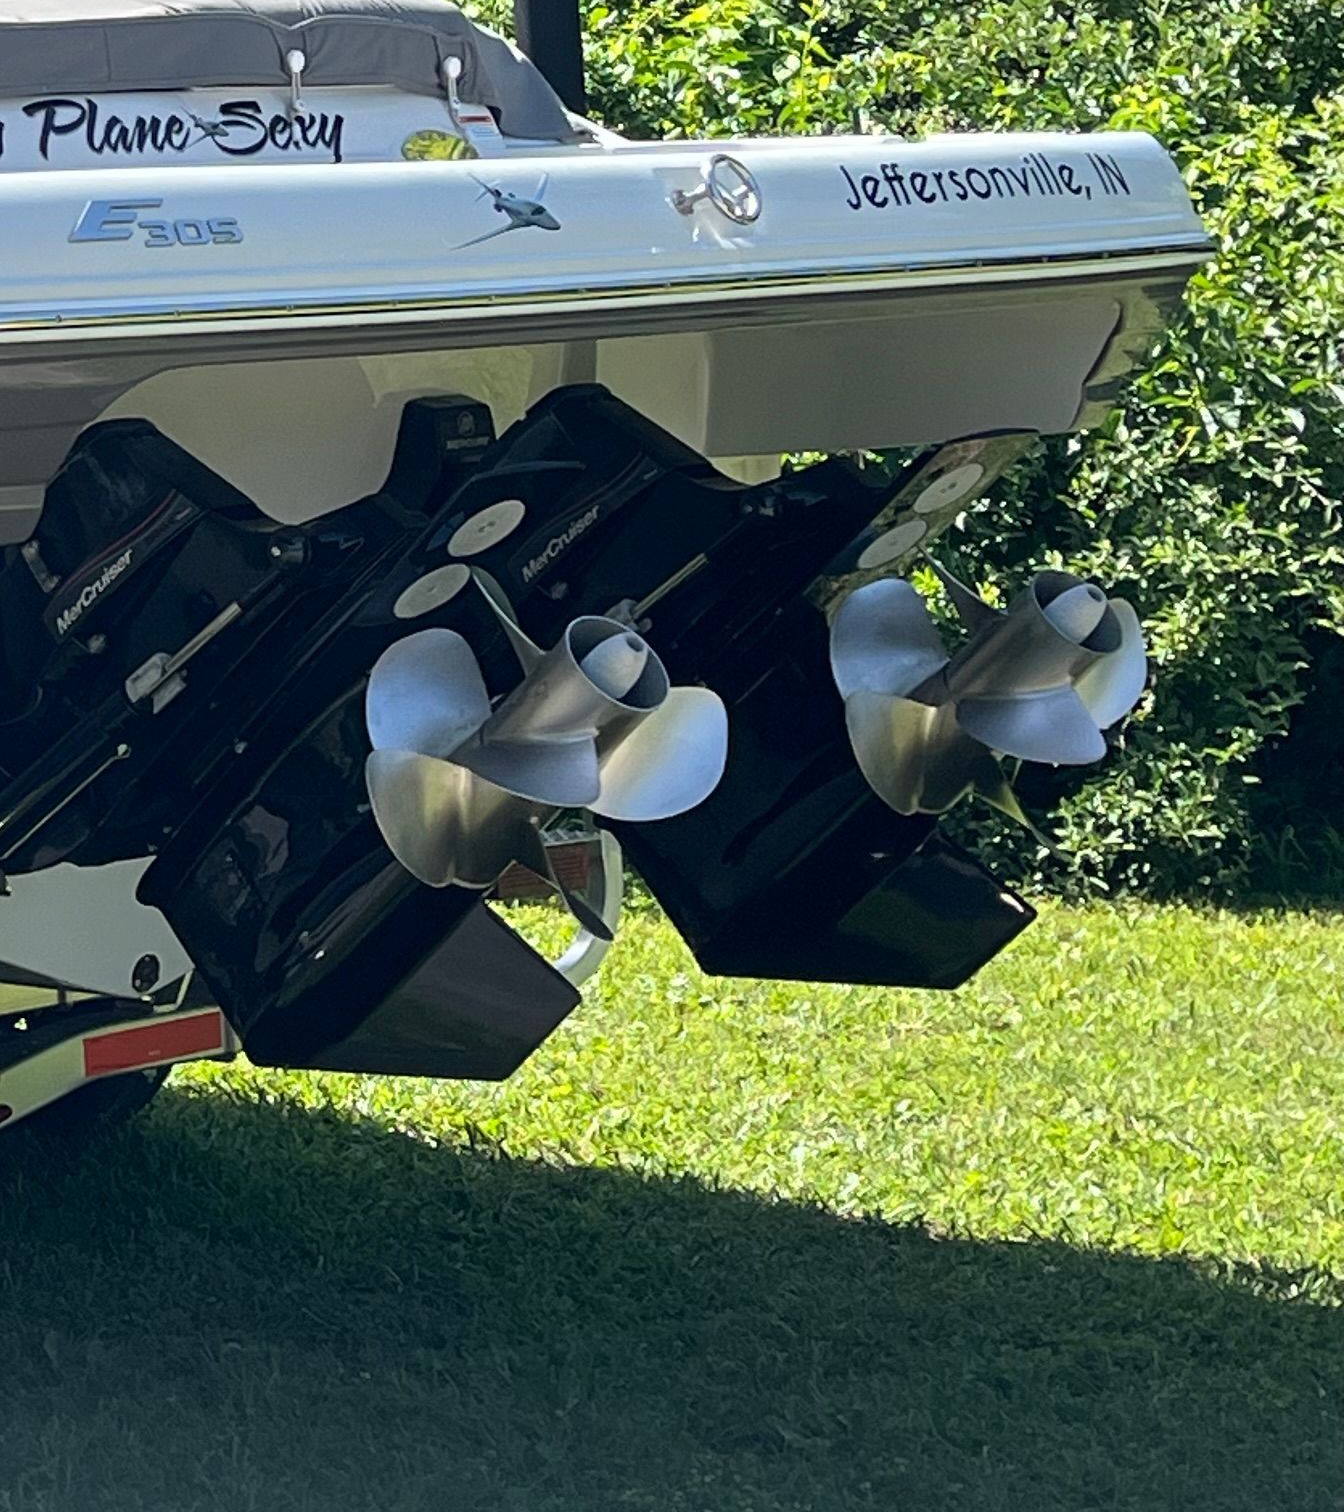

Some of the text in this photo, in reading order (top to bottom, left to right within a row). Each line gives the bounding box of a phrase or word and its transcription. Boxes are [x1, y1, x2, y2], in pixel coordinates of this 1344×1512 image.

[22, 98, 191, 161] Plane
[212, 100, 345, 165] Sexy
[839, 152, 1131, 210] Jeffersonville, IN
[520, 503, 600, 583] MerCruiser
[56, 548, 133, 635] MerCruiser
